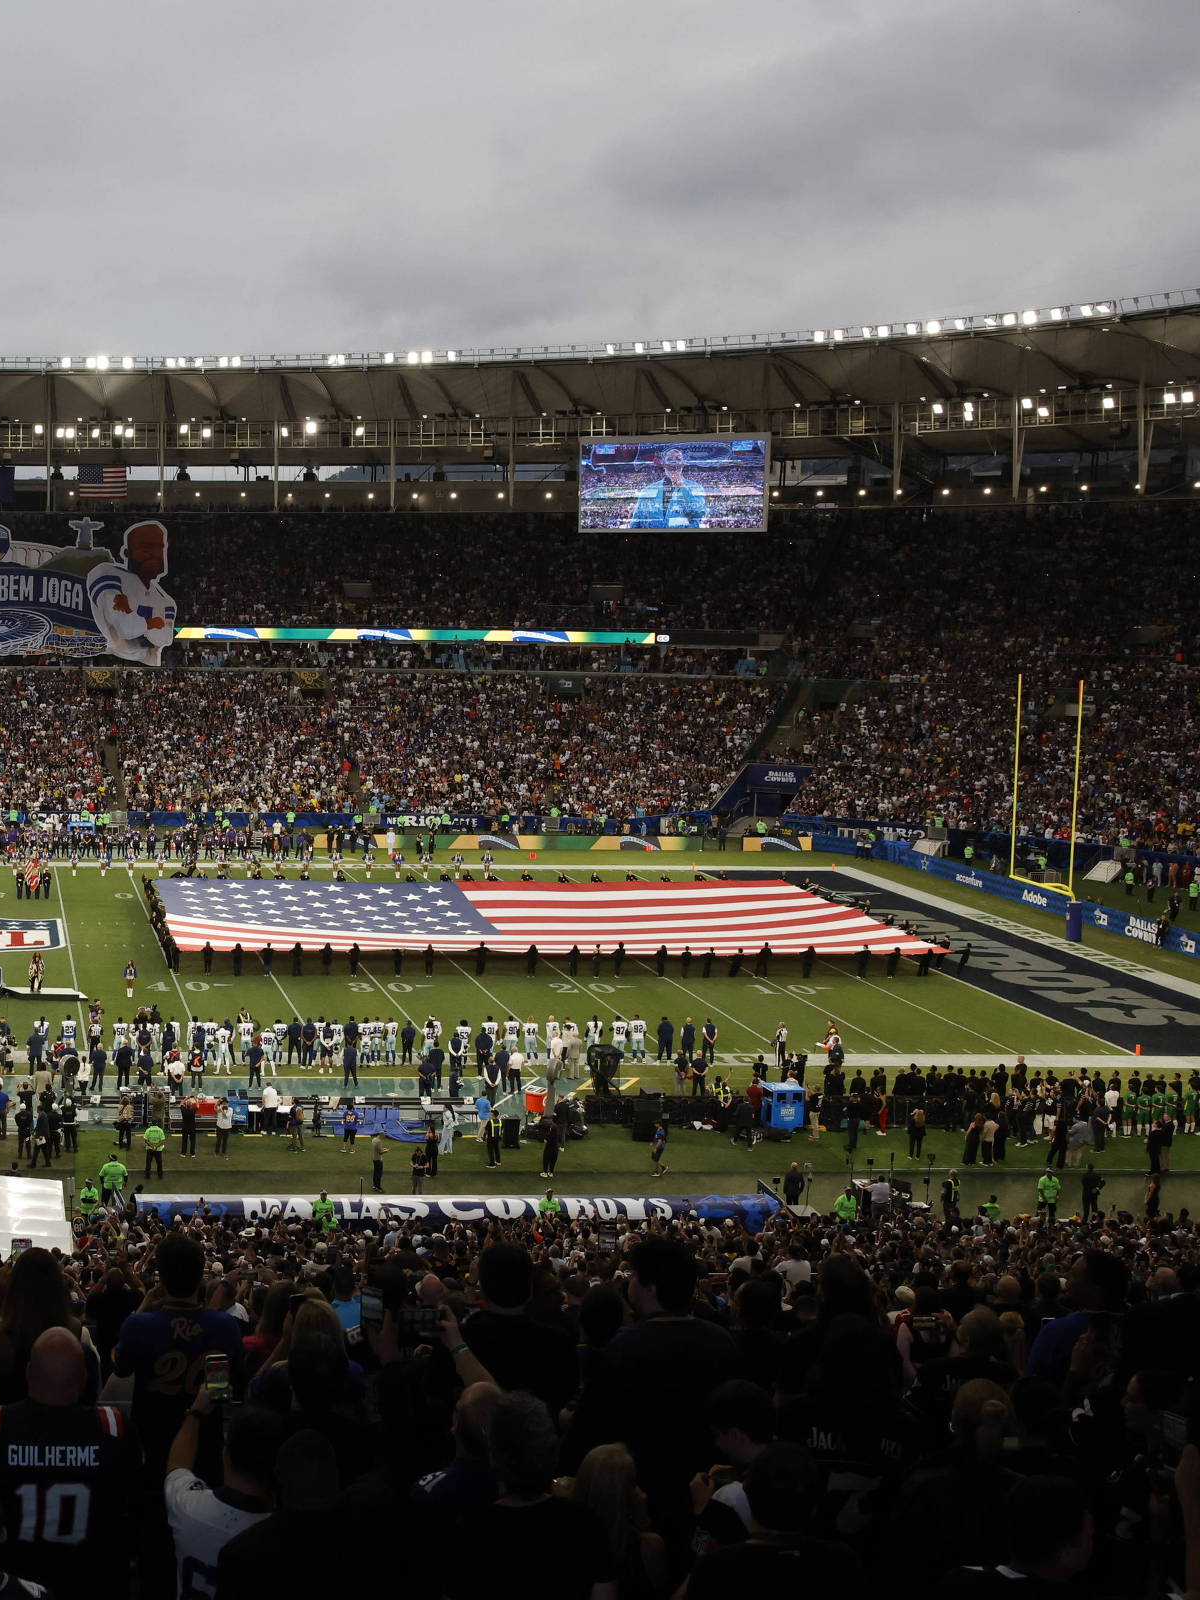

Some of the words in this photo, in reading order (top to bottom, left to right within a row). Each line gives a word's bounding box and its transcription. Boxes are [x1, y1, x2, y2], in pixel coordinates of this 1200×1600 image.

[39, 576, 84, 612] JOGA
[955, 873, 983, 889] accenture
[1022, 889, 1048, 907] Adobe
[965, 912, 1047, 942] INSPIRE
[1052, 939, 1158, 975] CHANGE
[145, 981, 210, 992] 40
[347, 982, 413, 993] 30
[548, 982, 616, 994] 20
[65, 1025, 74, 1034] 23
[526, 1027, 536, 1036] 44
[615, 1026, 625, 1035] 97
[633, 1025, 644, 1034] 92
[221, 1035, 226, 1044] 3
[459, 1031, 469, 1040] 53
[7, 1443, 101, 1468] GUILHERME
[14, 1481, 93, 1546] 10
